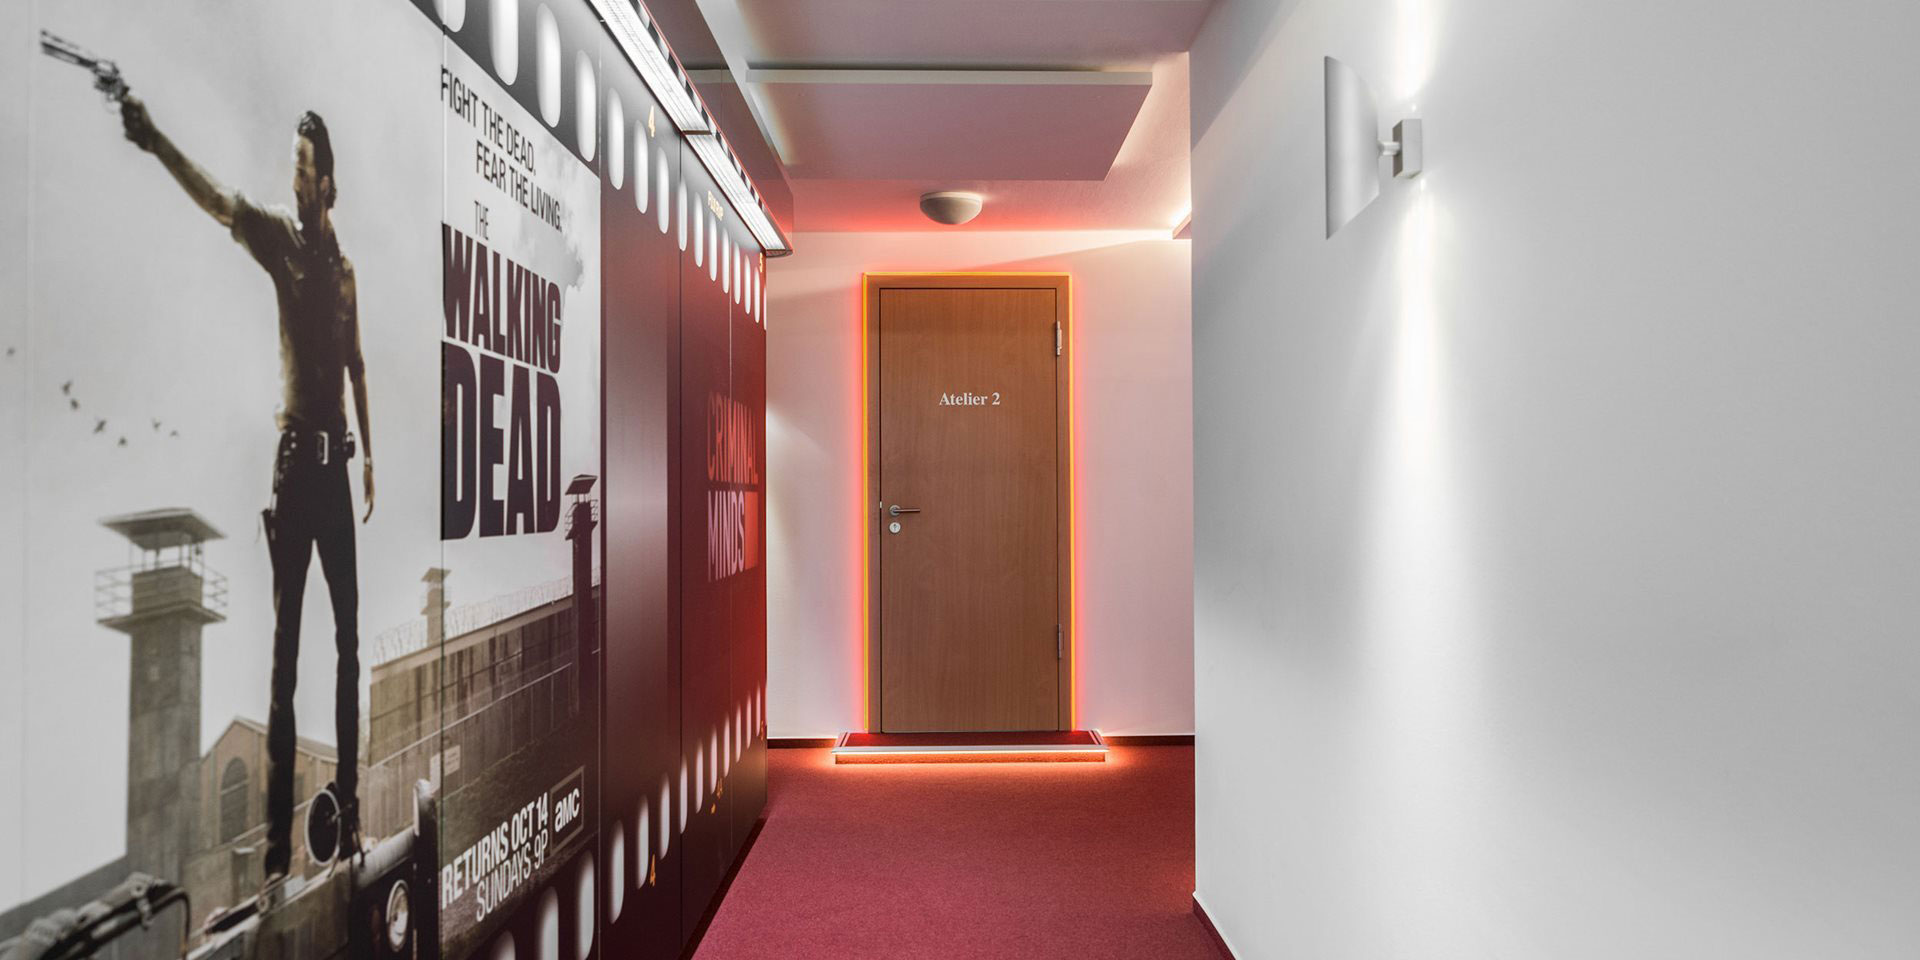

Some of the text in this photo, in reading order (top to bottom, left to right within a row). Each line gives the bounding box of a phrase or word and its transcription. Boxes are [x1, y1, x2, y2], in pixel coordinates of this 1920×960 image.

[440, 64, 537, 176] FIGHT THE DEAD.
[474, 200, 490, 241] THE
[476, 140, 563, 233] FEAR THE LIVING.
[441, 221, 561, 374] WALKING
[441, 340, 561, 541] DEAD
[707, 391, 759, 485] CRIMINAL
[939, 392, 1001, 406] Atelier 2
[708, 490, 745, 583] MINDS
[442, 792, 549, 911] RETURNS OCT 14
[476, 828, 549, 922] SUNDAYS 9P
